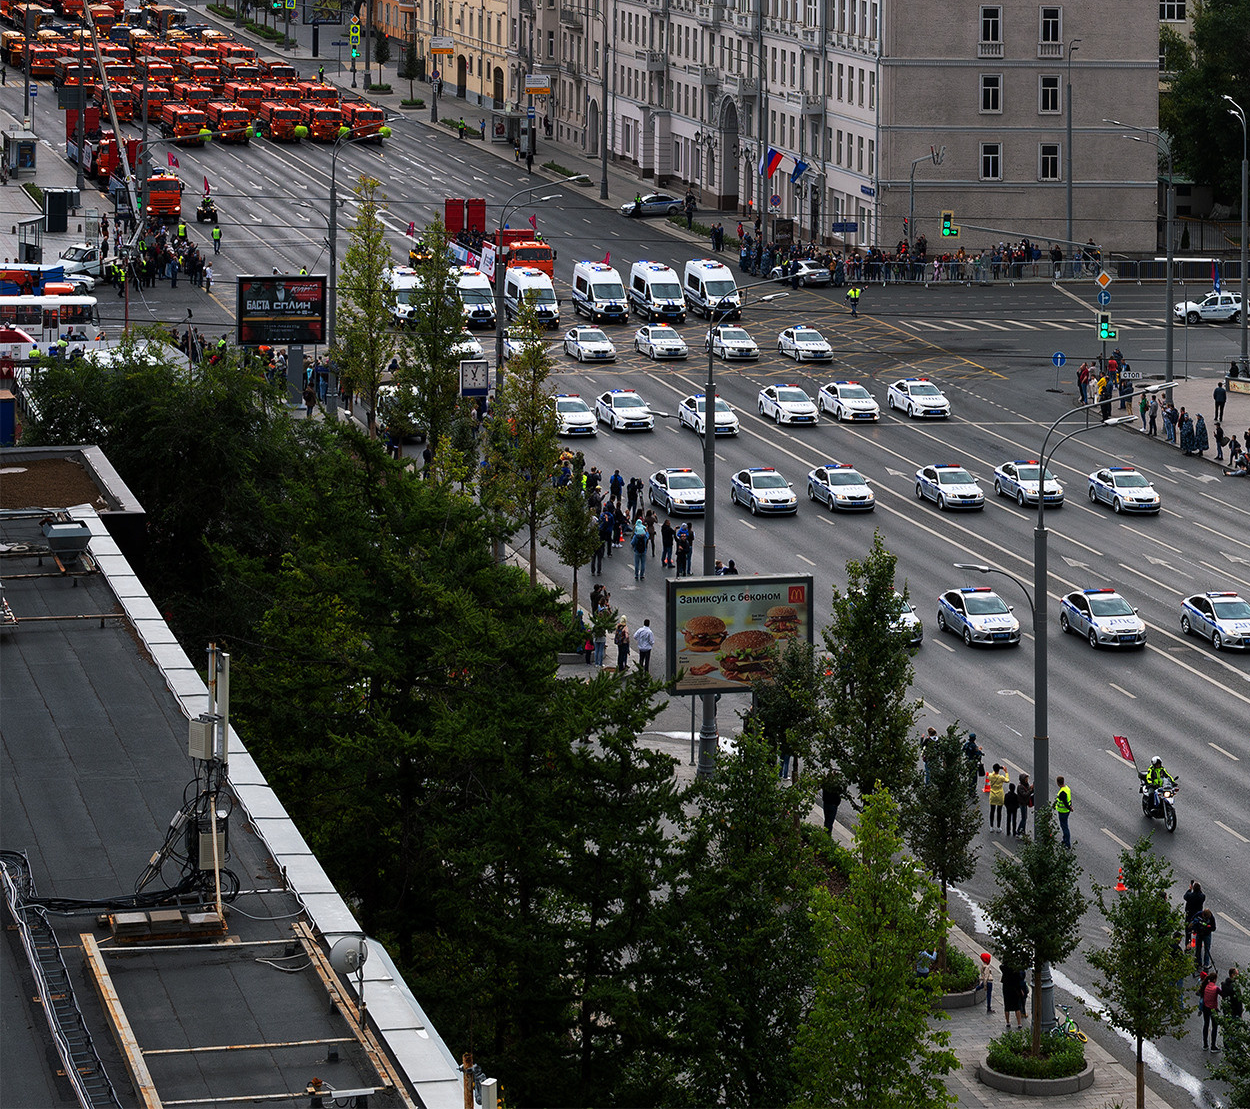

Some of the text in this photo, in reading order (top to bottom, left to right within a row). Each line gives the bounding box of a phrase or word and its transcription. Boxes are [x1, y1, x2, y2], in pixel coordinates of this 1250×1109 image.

[246, 300, 270, 310] БАСТА
[680, 593, 728, 605] Замиксуй
[738, 592, 781, 602] беконом
